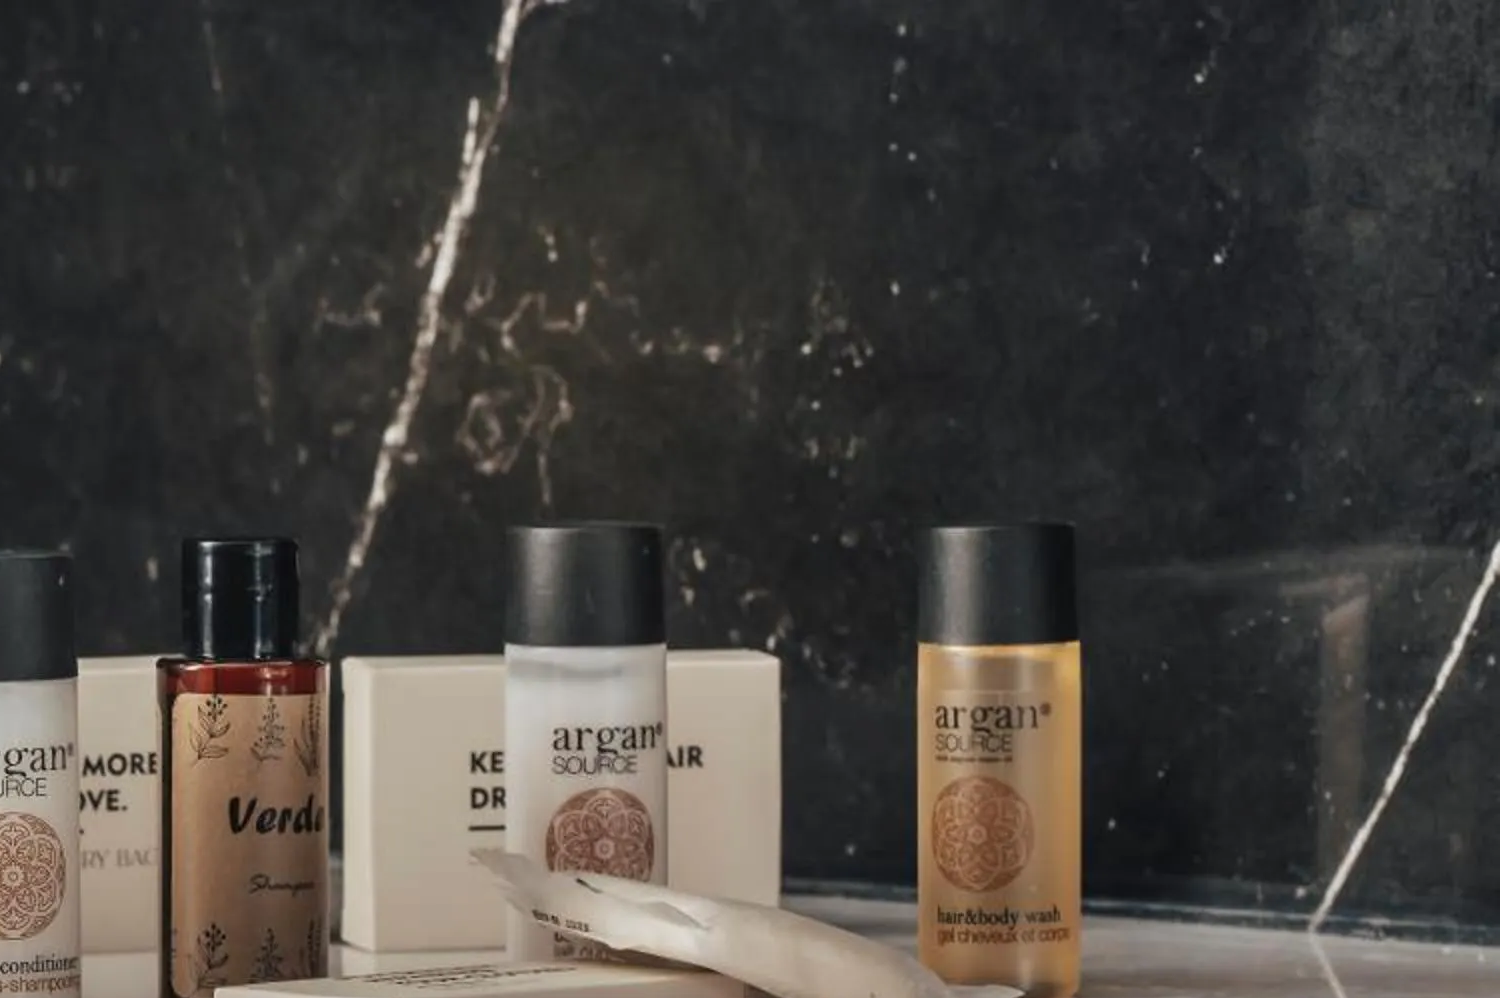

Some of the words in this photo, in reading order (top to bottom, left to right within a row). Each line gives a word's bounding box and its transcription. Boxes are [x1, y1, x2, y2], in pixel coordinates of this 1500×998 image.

[934, 733, 1013, 752] SOURCE
[82, 752, 158, 777] MORE
[551, 755, 638, 775] SOURCE
[1024, 904, 1062, 923] wash
